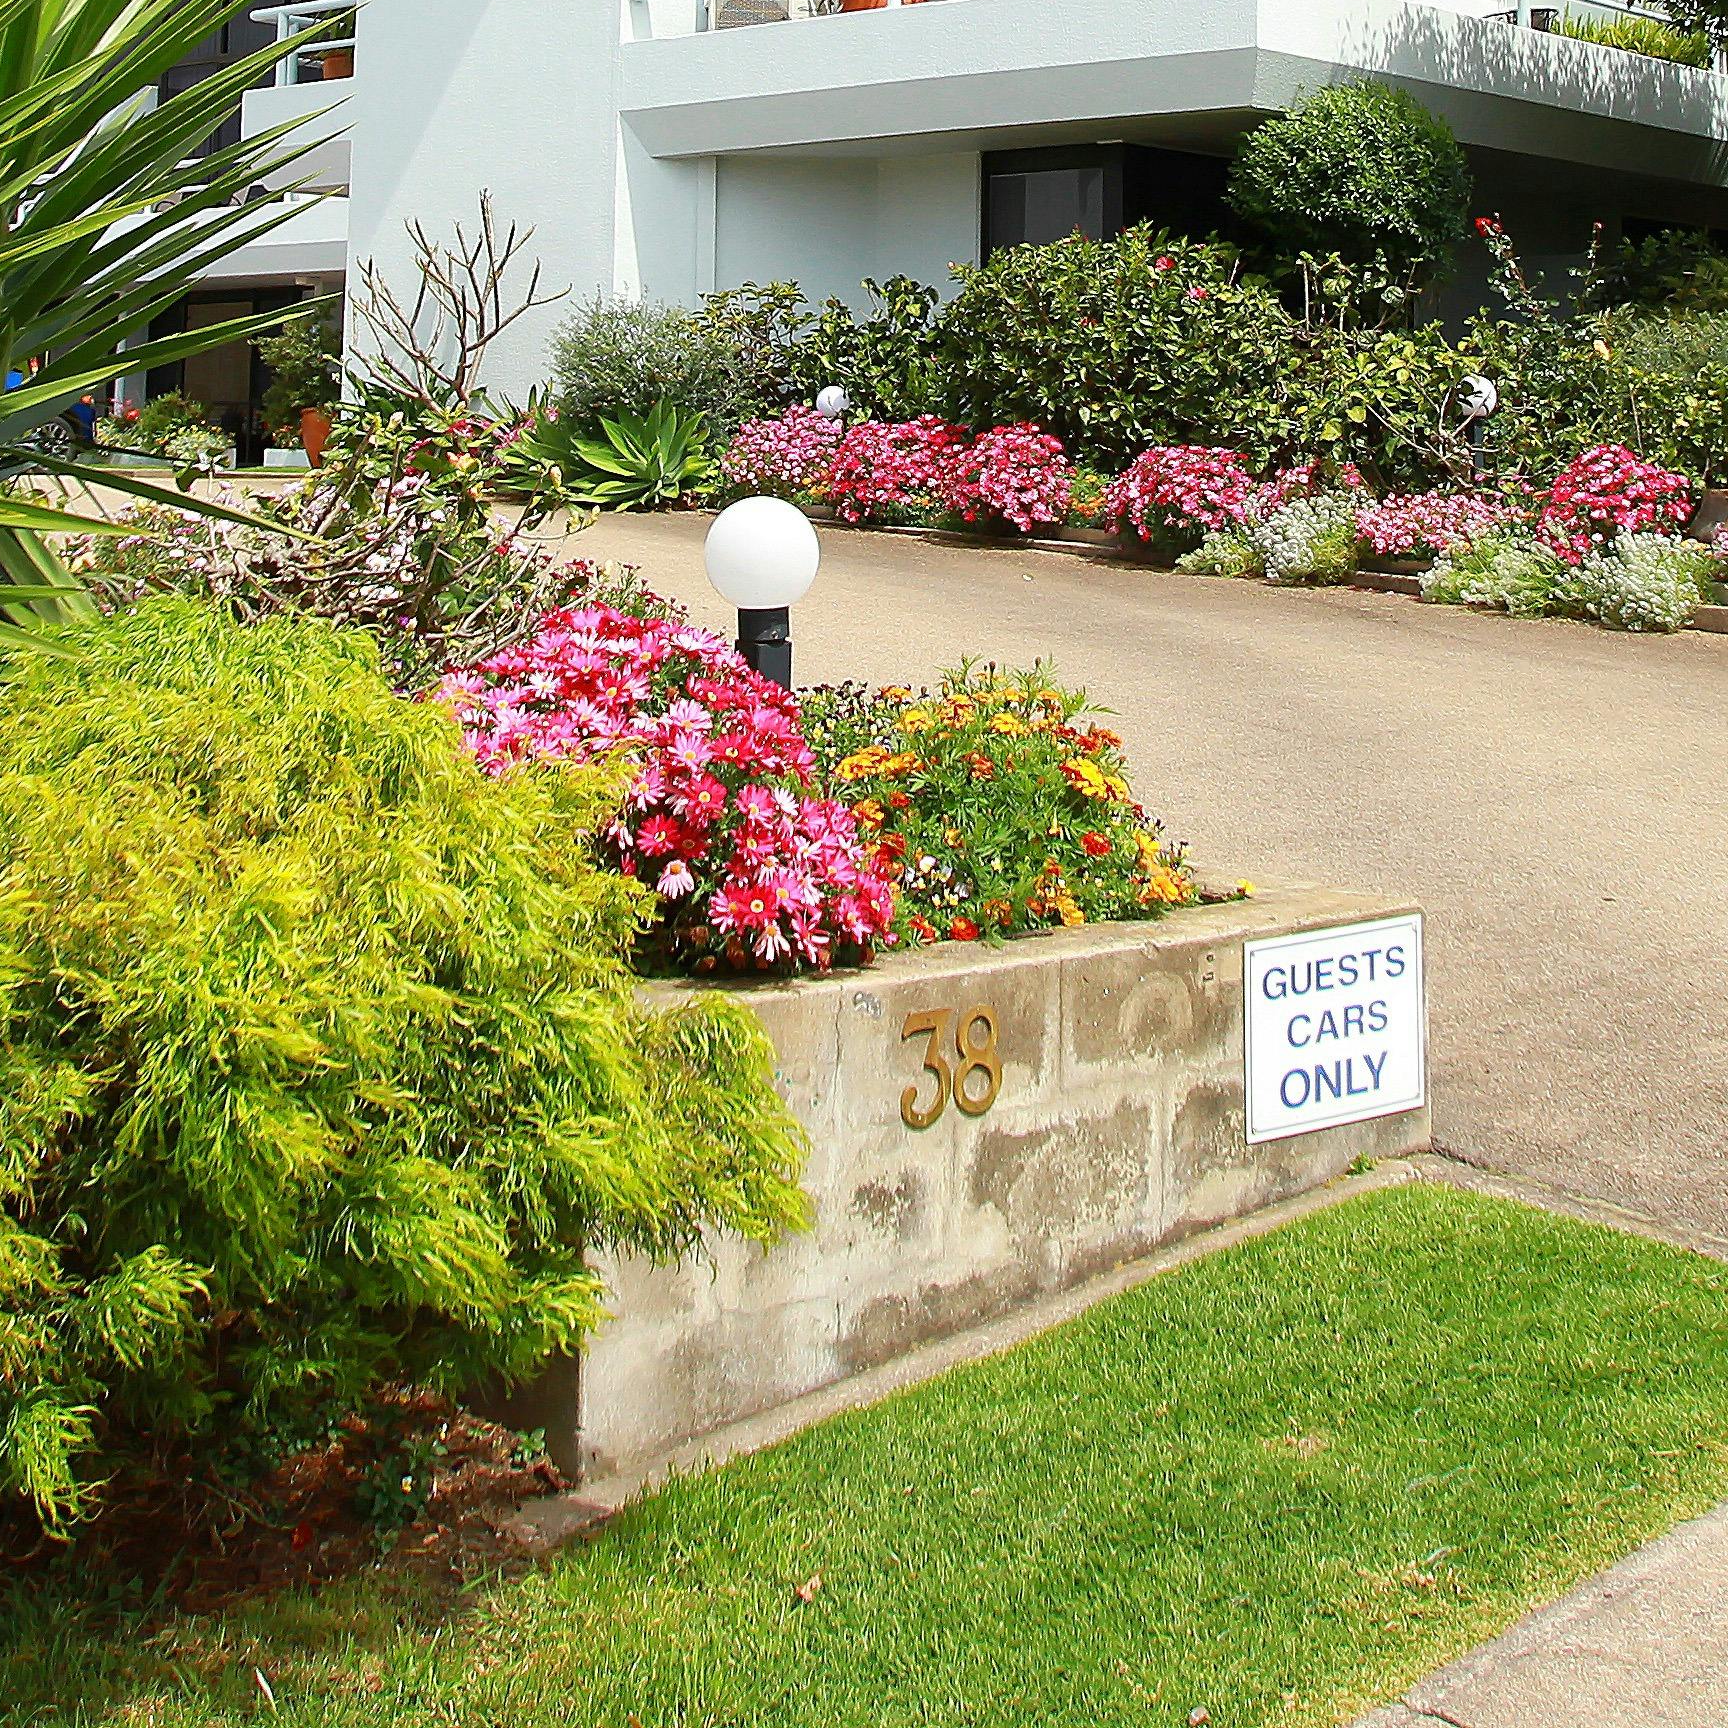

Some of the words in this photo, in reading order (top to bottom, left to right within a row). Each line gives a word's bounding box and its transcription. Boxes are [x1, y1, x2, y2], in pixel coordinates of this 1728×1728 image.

[1261, 945, 1406, 1001] GUESTS
[1286, 999, 1389, 1048] CARS
[901, 1003, 1003, 1129] 38
[1279, 1050, 1389, 1109] ONLY
